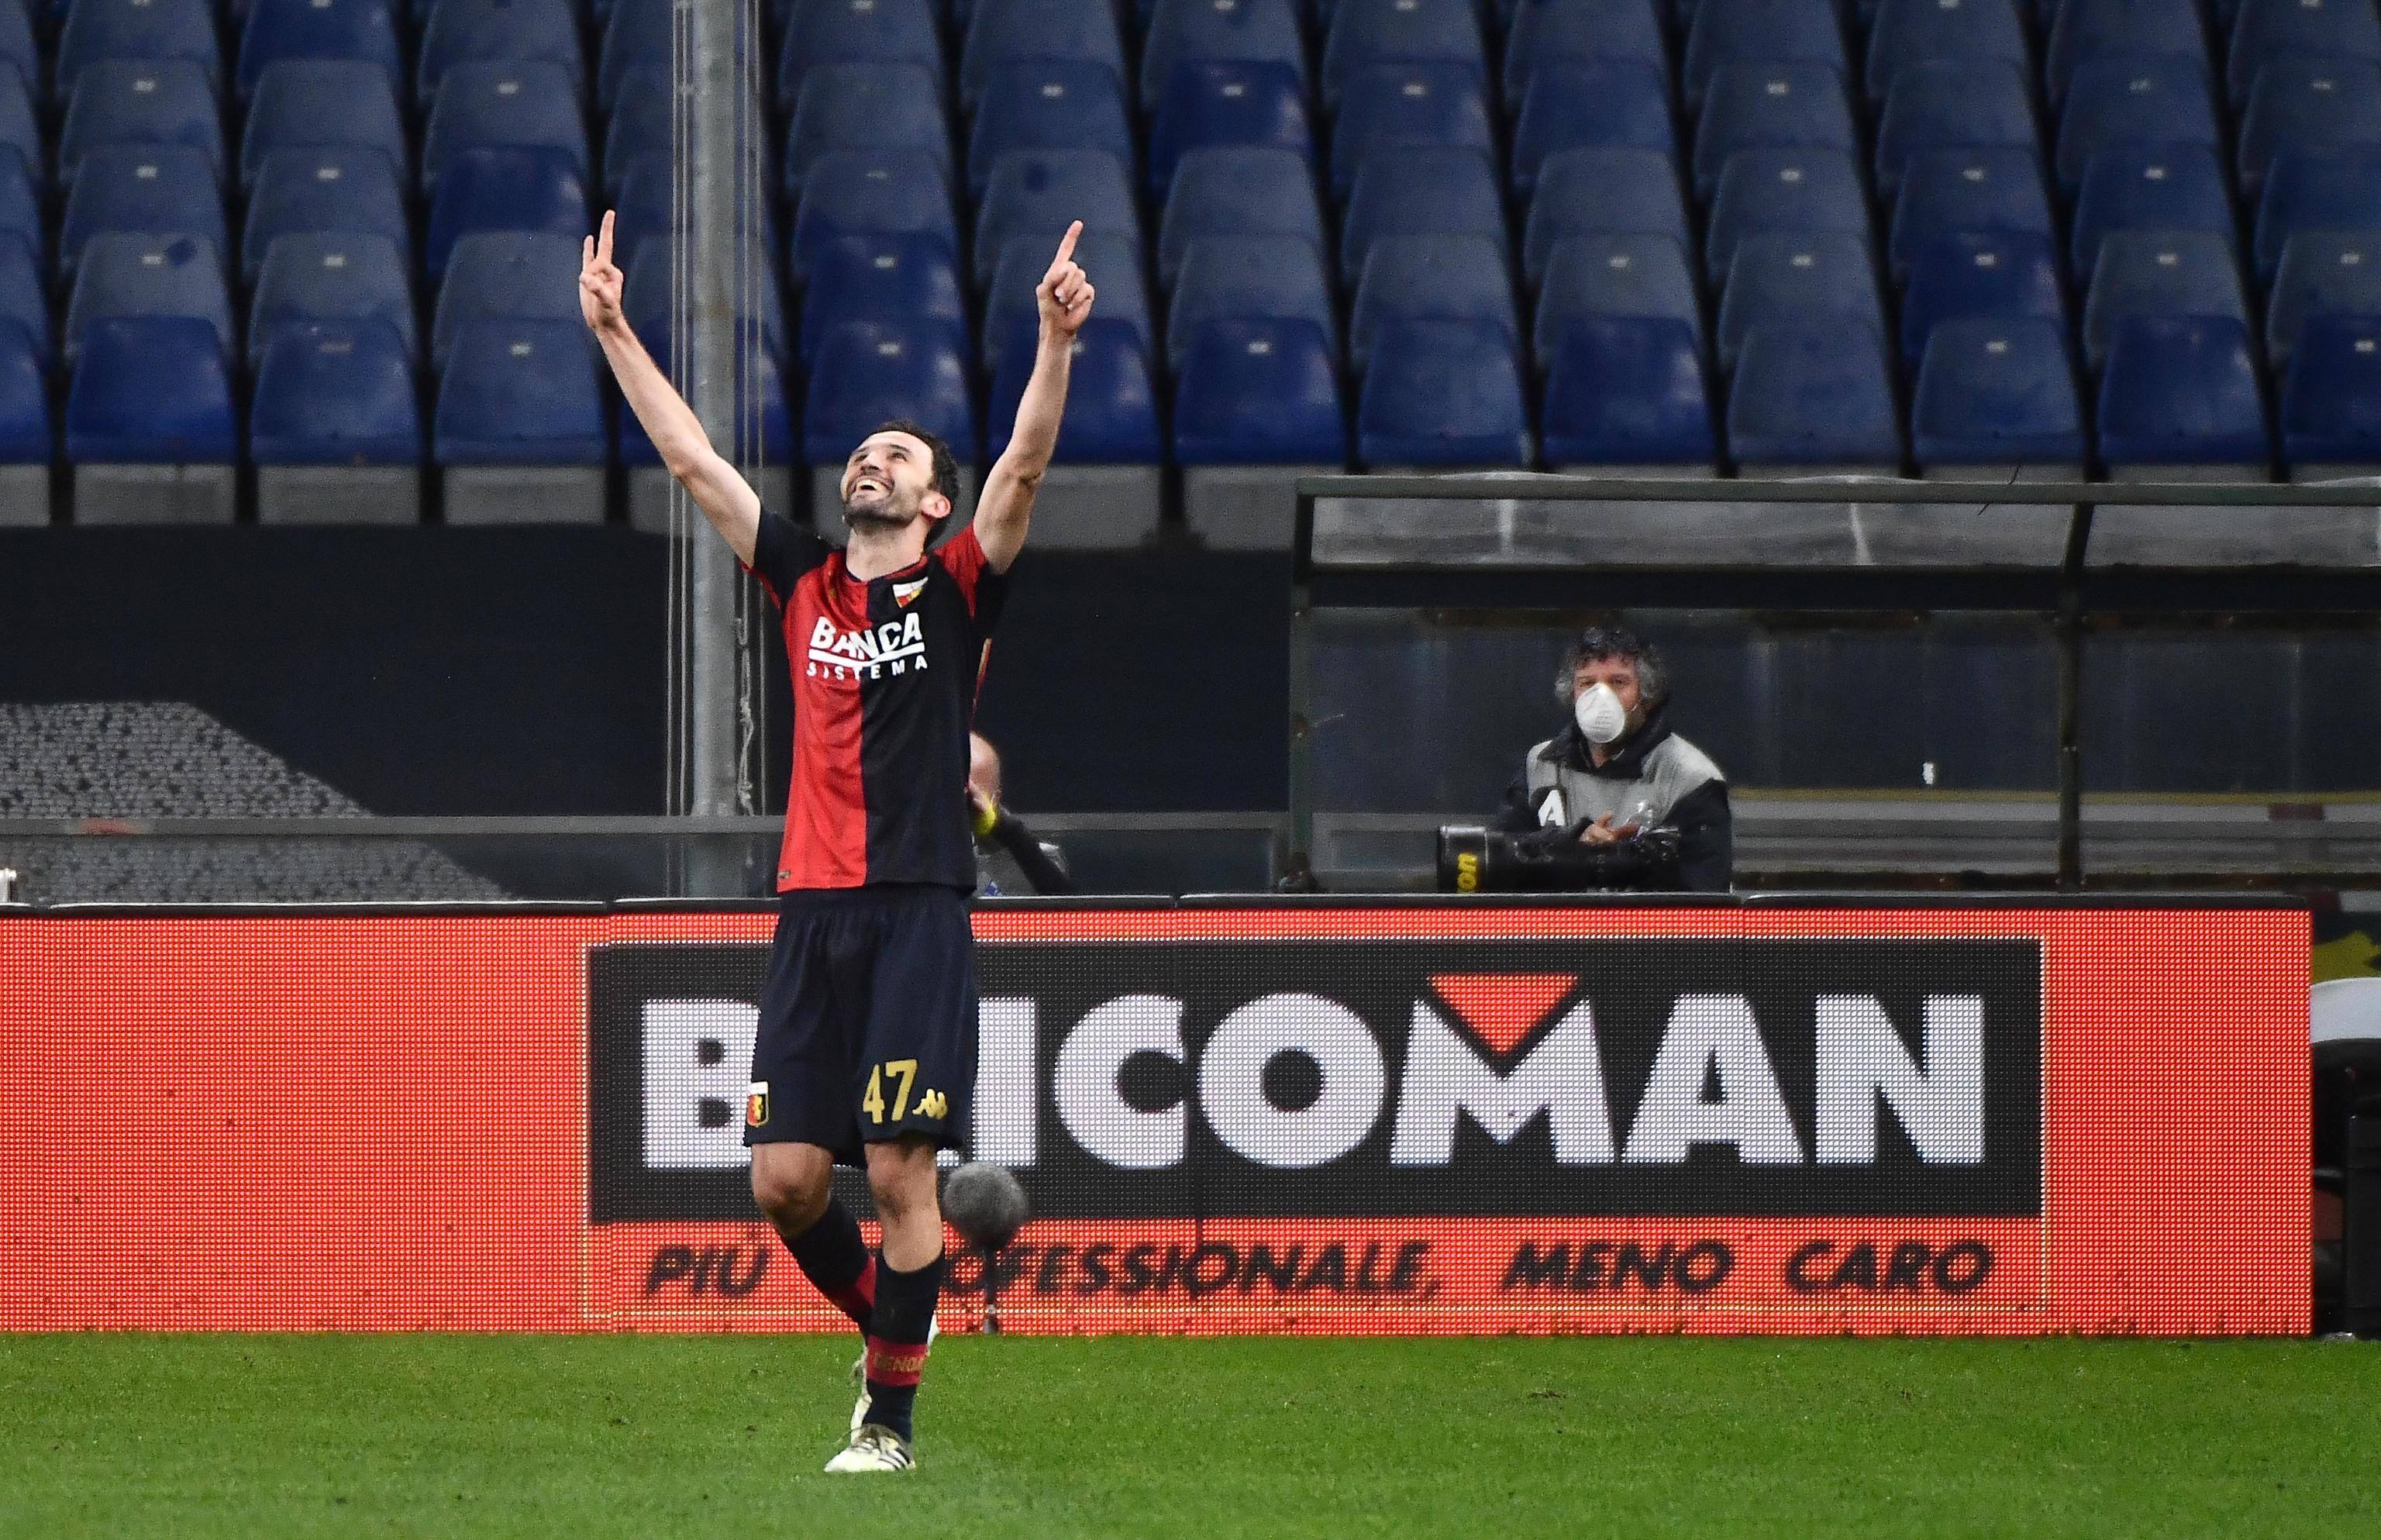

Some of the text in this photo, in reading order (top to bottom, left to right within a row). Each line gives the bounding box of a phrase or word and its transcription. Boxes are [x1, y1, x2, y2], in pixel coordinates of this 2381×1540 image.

[809, 612, 923, 660] BANCA
[806, 654, 929, 681] SISTEMA
[640, 993, 1987, 1172] BICOMAN
[862, 1058, 918, 1125] 47
[1502, 1239, 1735, 1295] MENO
[1784, 1239, 1993, 1295] CARO
